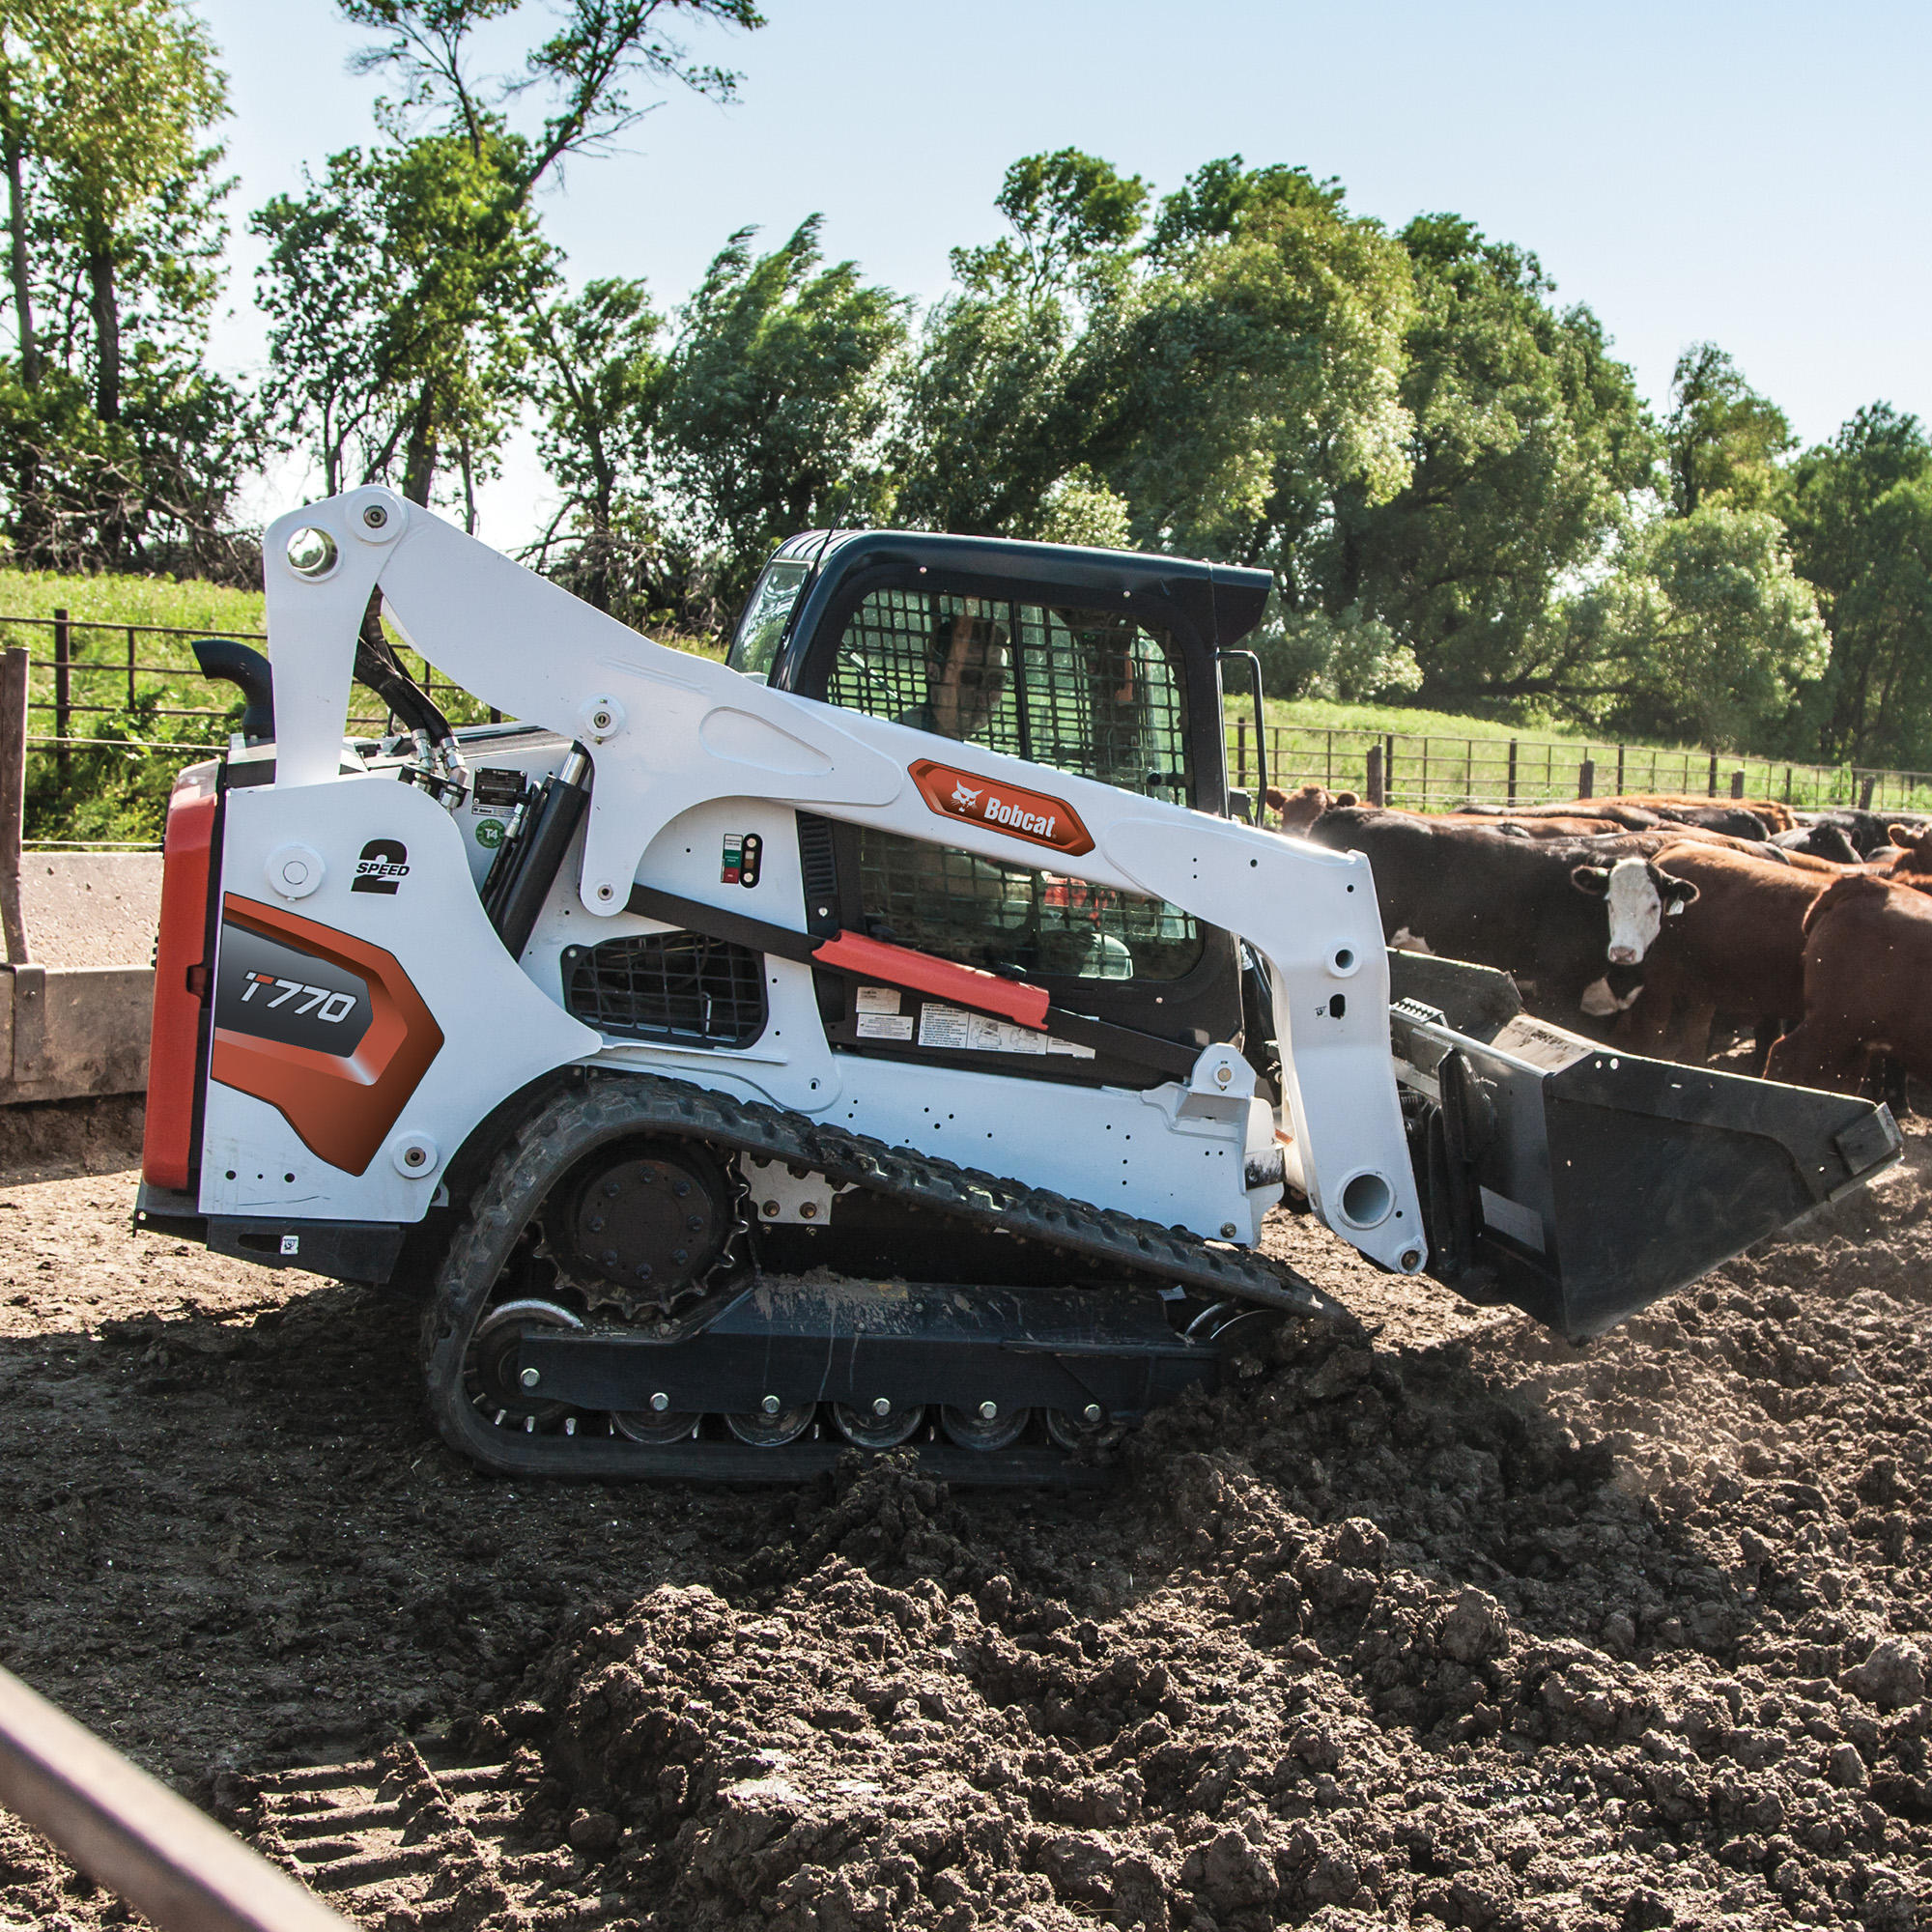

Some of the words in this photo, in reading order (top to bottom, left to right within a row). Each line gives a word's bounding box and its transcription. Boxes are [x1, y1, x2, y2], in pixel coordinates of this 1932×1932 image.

[485, 828, 498, 839] T4
[983, 796, 1056, 838] Bobcat
[351, 838, 408, 895] 2
[355, 862, 411, 877] SPEED
[241, 970, 357, 1024] T770
